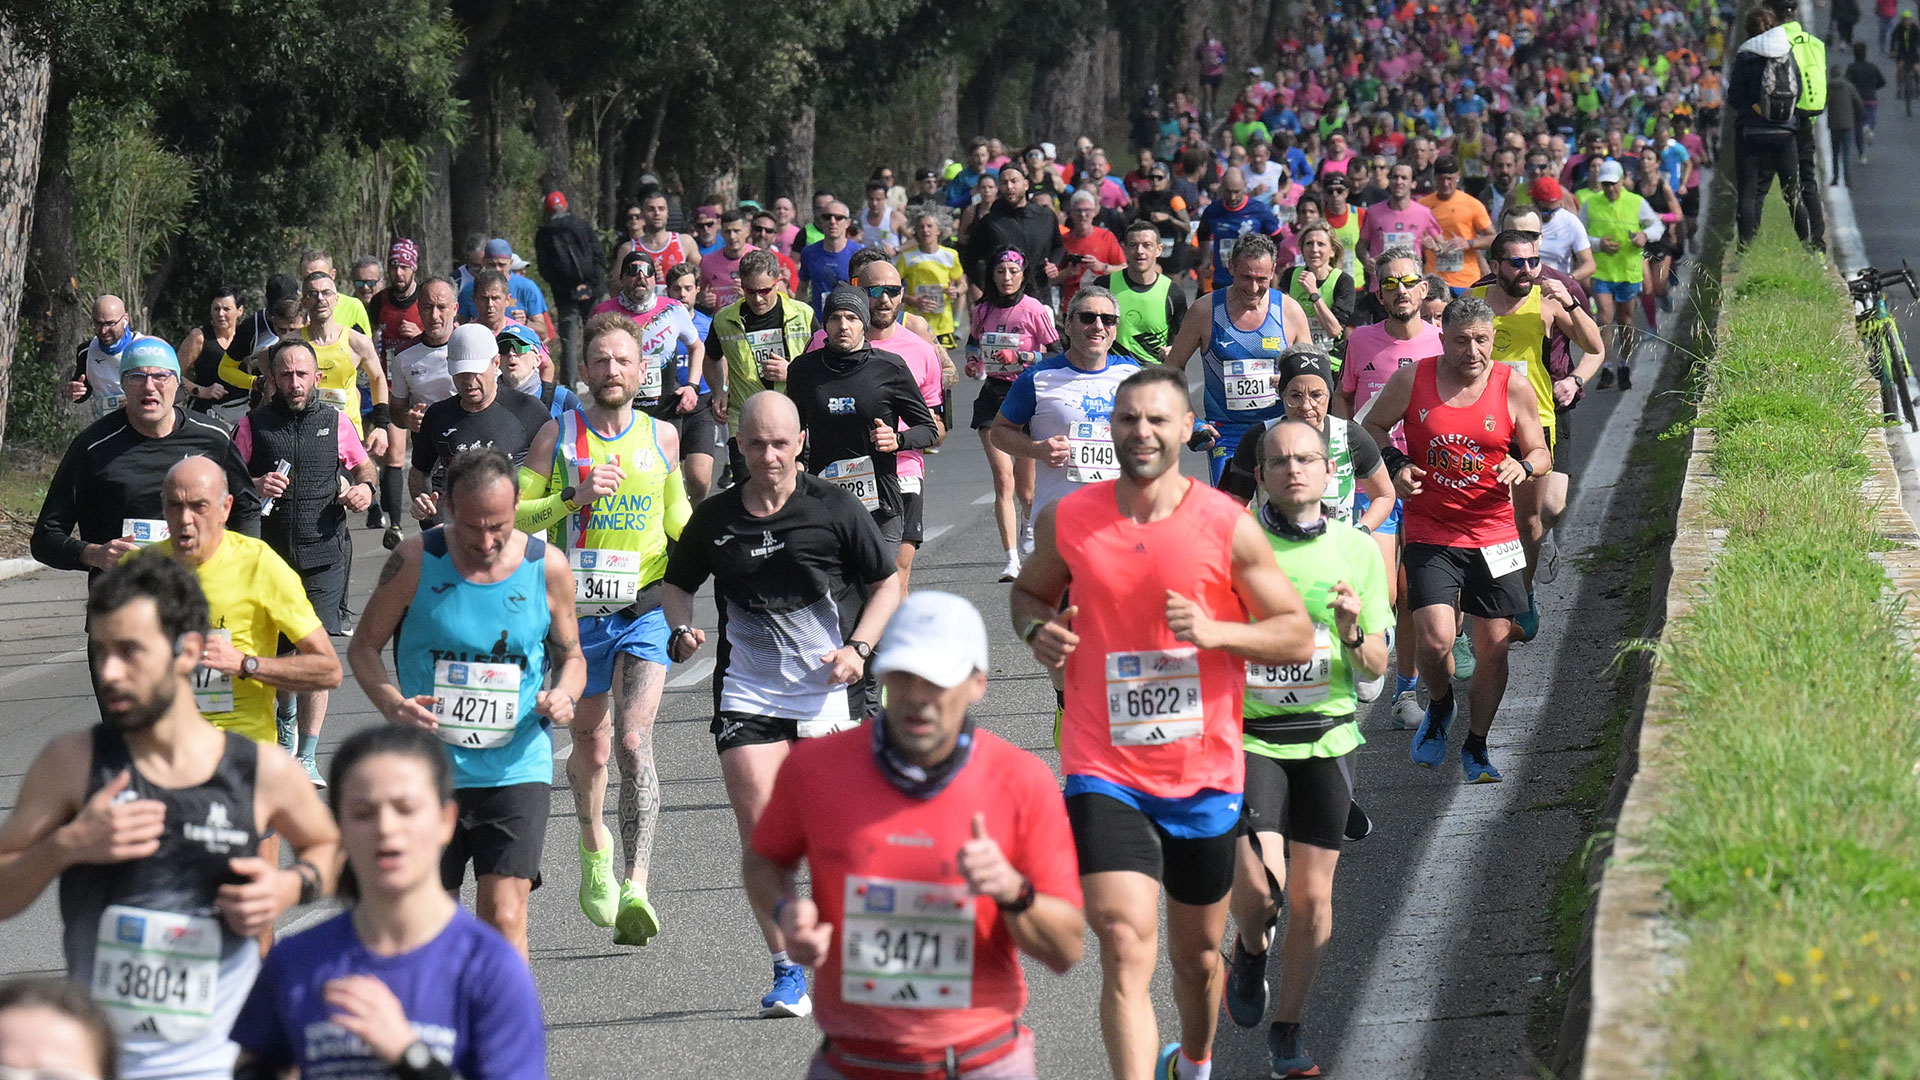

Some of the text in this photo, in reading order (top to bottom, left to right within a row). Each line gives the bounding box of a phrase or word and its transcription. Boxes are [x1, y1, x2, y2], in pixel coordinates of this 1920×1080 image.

[1237, 380, 1264, 396] 5231
[1430, 433, 1480, 453] ATLETICA
[1081, 446, 1113, 465] 6149
[1432, 472, 1480, 489] CECCANO
[572, 513, 646, 531] RUNNERS
[585, 578, 620, 599] 3411
[1266, 659, 1313, 682] 9382
[452, 697, 497, 724] 4271
[1127, 687, 1180, 717] 6622
[874, 929, 940, 968] 3471
[117, 962, 187, 1003] 3804
